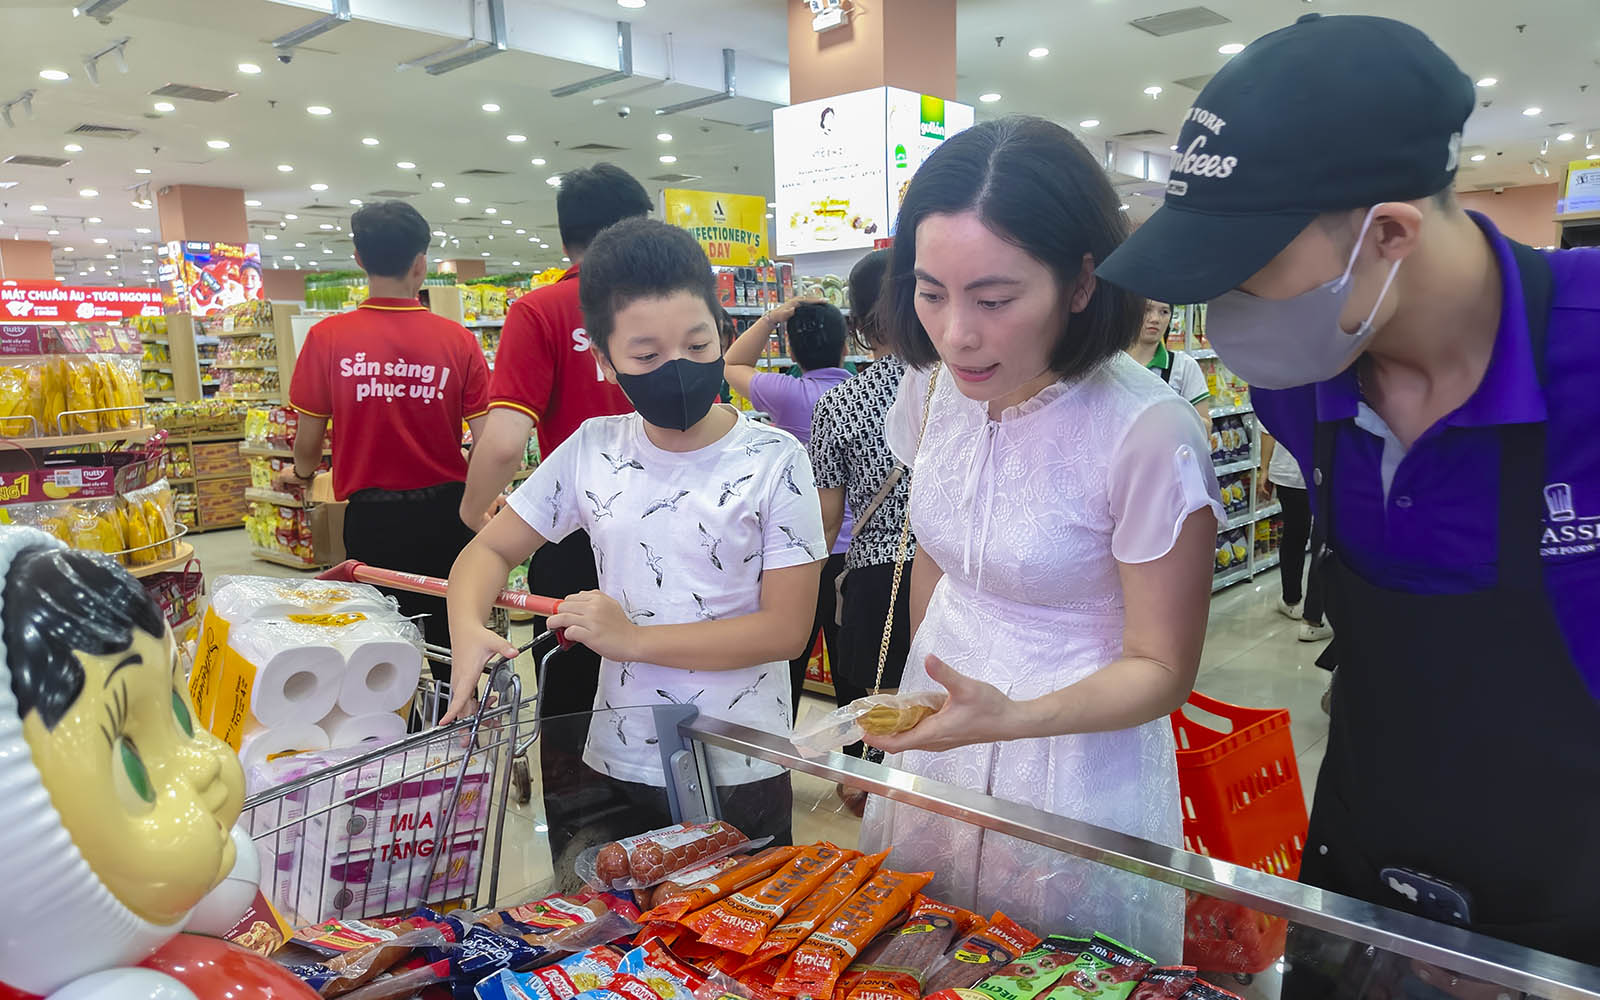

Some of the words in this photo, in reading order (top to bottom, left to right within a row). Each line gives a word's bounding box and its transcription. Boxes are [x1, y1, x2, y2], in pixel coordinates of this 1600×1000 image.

[1192, 107, 1226, 135] YORK
[708, 242, 731, 258] DAY
[119, 292, 150, 302] NGON
[3, 326, 28, 337] nutty
[340, 352, 380, 377] Sẵn
[384, 358, 435, 383] sàng
[356, 378, 406, 402] phục
[83, 470, 106, 480] nutty
[389, 811, 434, 833] MUA
[381, 838, 434, 865] TẶNG
[987, 926, 1024, 950] РЕМИТ
